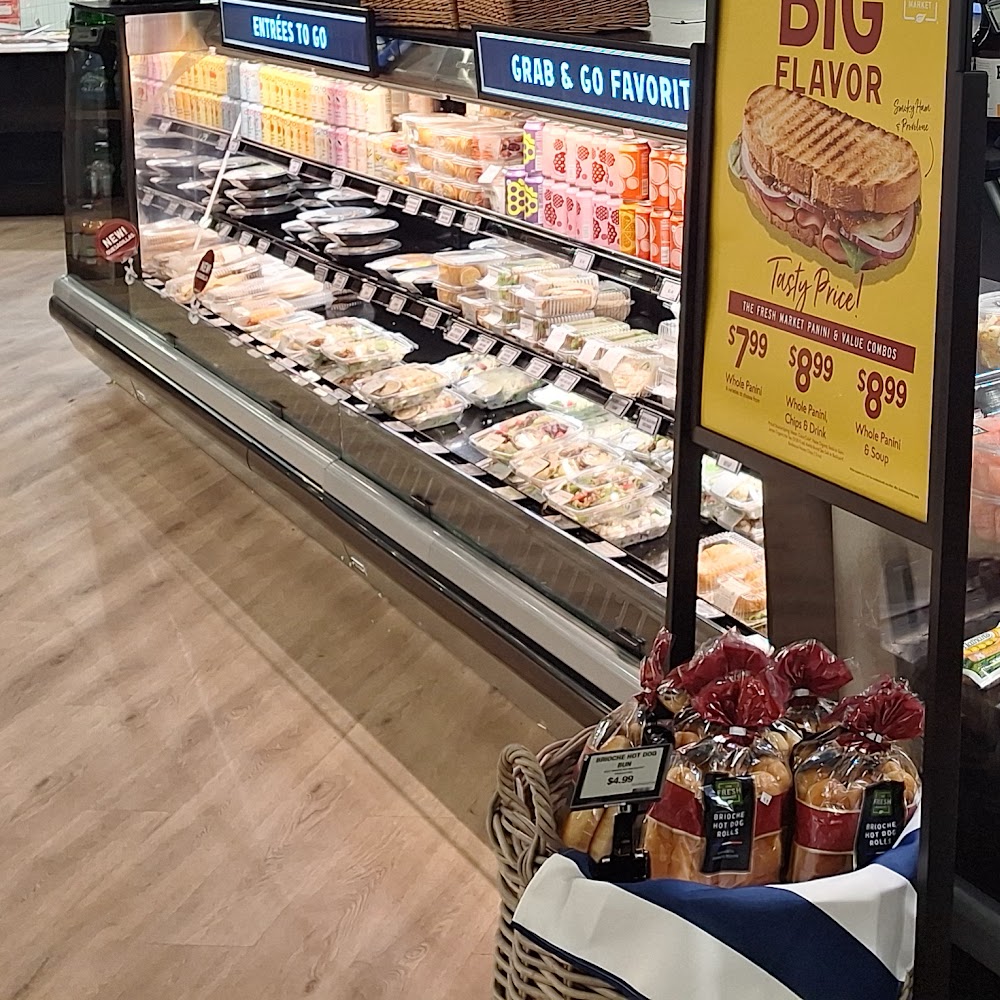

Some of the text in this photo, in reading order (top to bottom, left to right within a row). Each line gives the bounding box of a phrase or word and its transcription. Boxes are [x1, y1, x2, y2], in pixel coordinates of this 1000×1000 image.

[909, 0, 932, 10] MARKET
[252, 13, 328, 49] ENTRÉES TO GO
[511, 54, 554, 88] GRAB
[560, 63, 574, 90] &
[580, 66, 603, 96] GO
[774, 55, 882, 105] FLAVOR
[102, 225, 128, 249] NEW!
[767, 256, 864, 318] Tasty Price!
[742, 300, 897, 360] THE FRESH MARKET PANINI & VALUE COMBOS
[725, 371, 763, 396] Whole Panini
[785, 395, 807, 414] Whole
[784, 412, 827, 439] Chips & Drink
[855, 421, 879, 442] Whole
[880, 431, 901, 450] Panini
[864, 443, 889, 467] & Soup
[595, 754, 625, 763] BRIOCHE
[607, 775, 634, 786] $4.99
[717, 787, 742, 796] FRESH
[713, 811, 745, 821] BRIOCHE
[729, 819, 744, 828] DOG
[716, 828, 739, 838] ROLLS
[865, 821, 897, 831] BRIOCHE
[865, 829, 897, 839] HOT DOG
[869, 838, 892, 847] ROLLS
